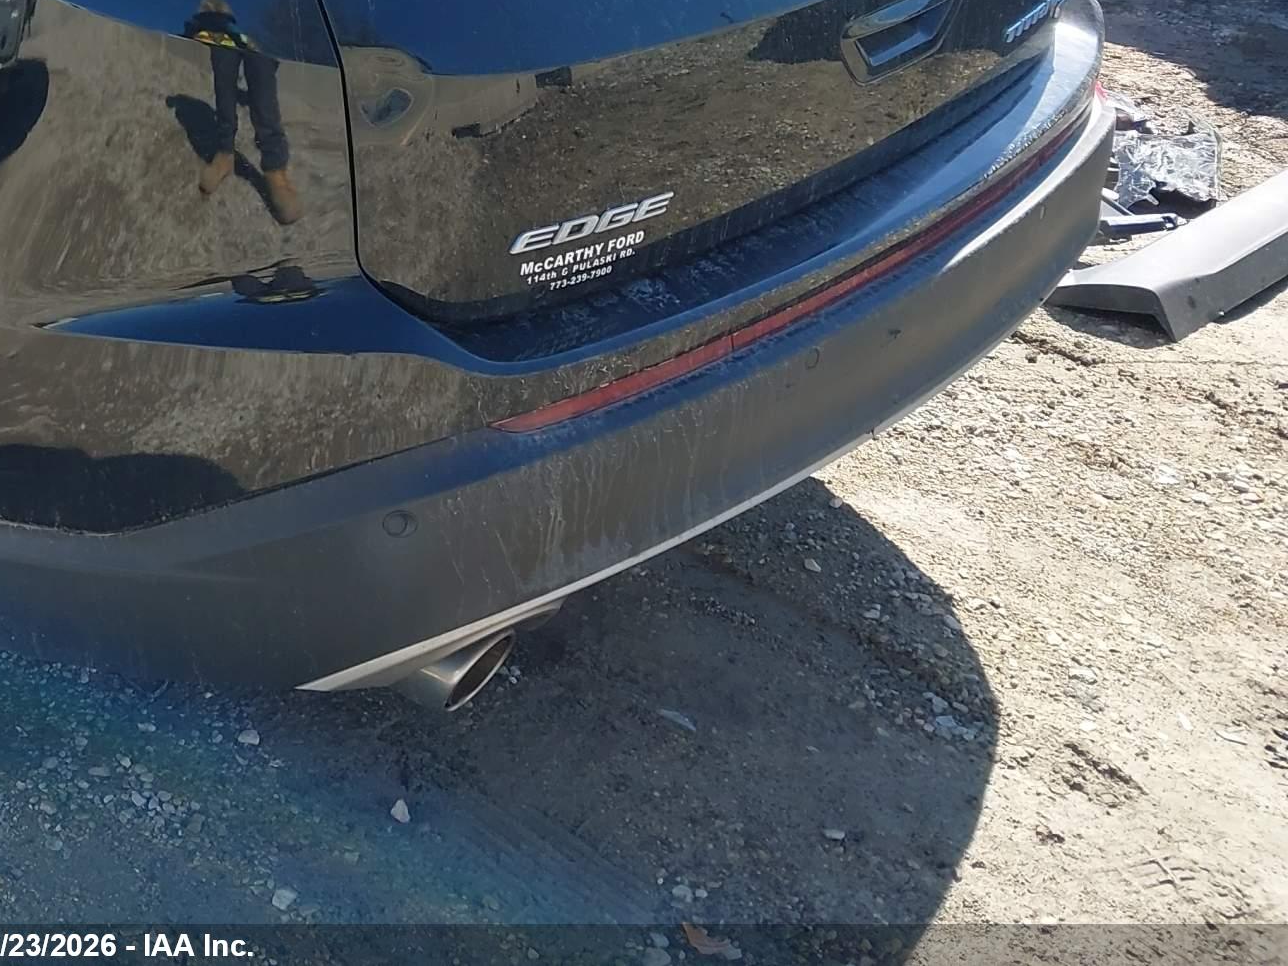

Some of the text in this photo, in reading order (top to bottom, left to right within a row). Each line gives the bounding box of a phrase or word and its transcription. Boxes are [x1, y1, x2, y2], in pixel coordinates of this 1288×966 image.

[509, 191, 675, 255] EDGE
[520, 230, 645, 276] McCARTHY FORD
[527, 271, 557, 285] 114th
[572, 253, 617, 273] PULASKI
[619, 248, 636, 259] RD.
[549, 265, 613, 291] 773-239-7900
